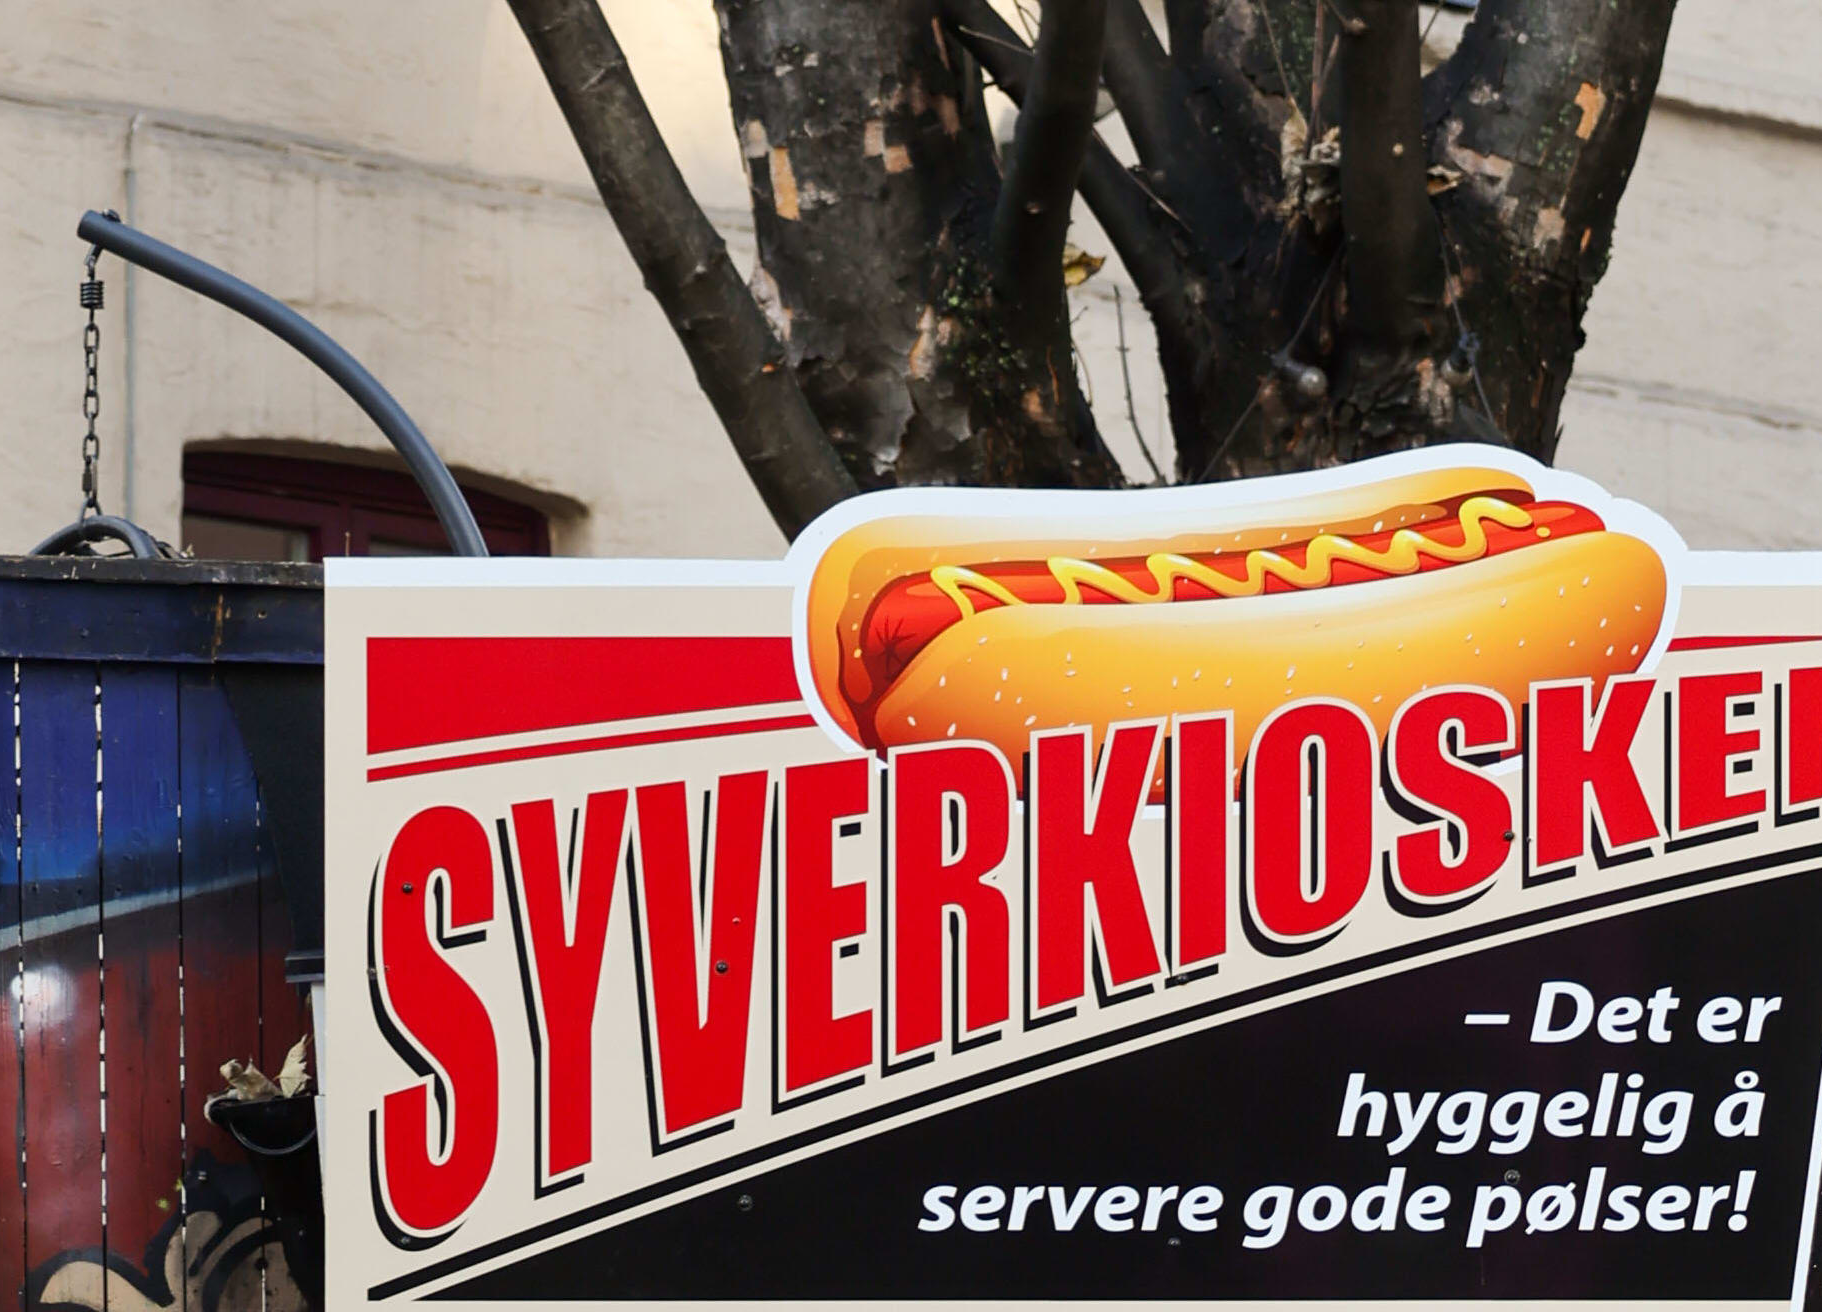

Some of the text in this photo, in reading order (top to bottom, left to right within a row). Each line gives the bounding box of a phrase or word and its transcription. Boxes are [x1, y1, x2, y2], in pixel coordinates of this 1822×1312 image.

[1530, 981, 1680, 1043] Det
[1697, 996, 1782, 1043] er
[1337, 1070, 1766, 1155] hyggelig å
[917, 1167, 1757, 1249] servere gode pølser!
